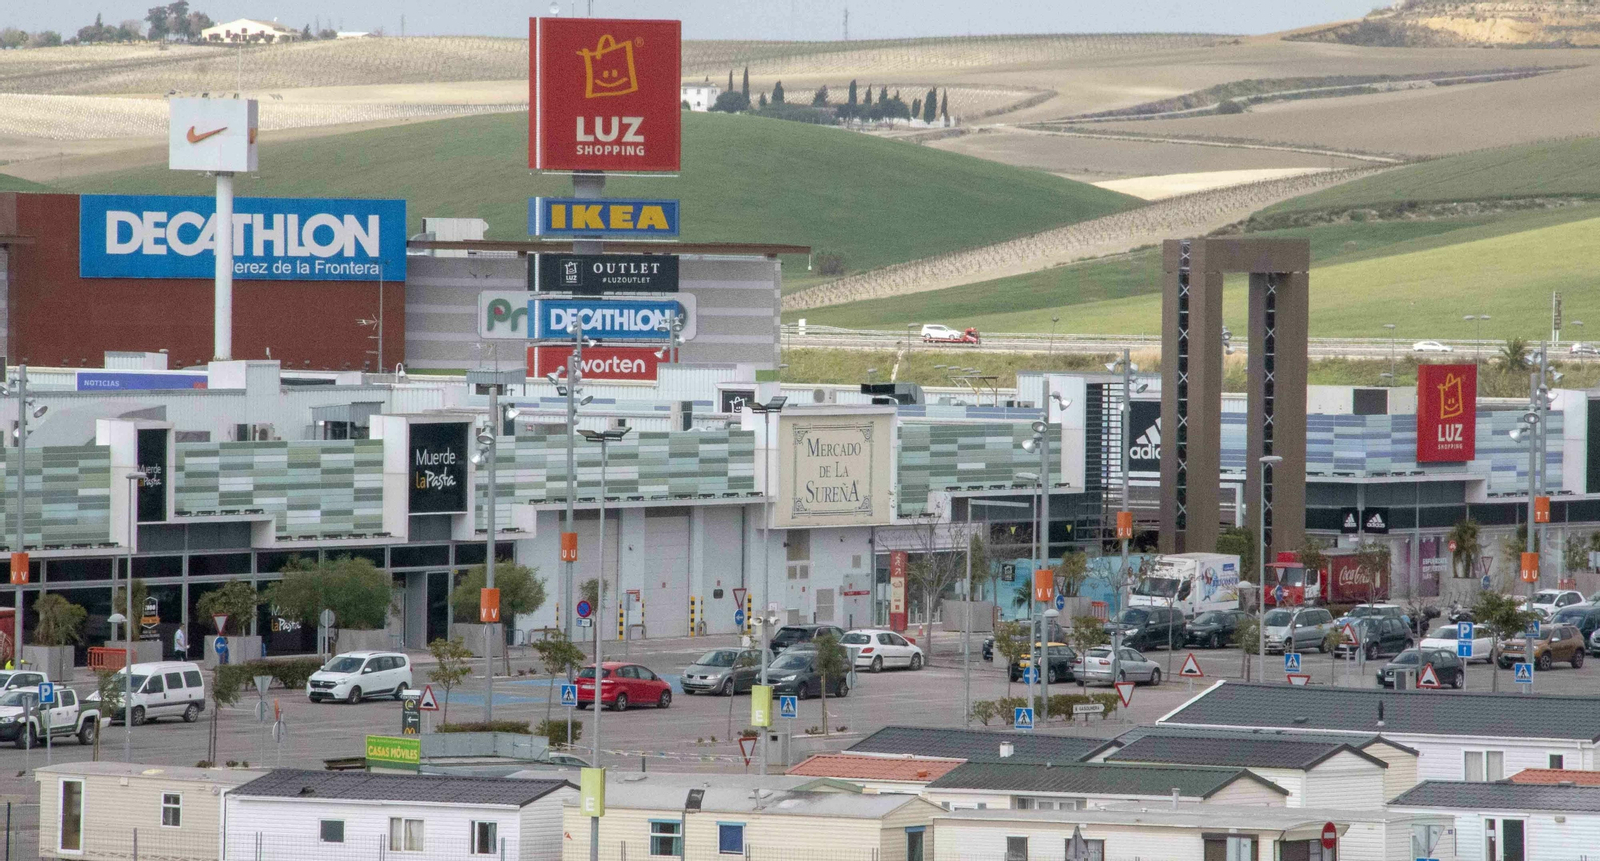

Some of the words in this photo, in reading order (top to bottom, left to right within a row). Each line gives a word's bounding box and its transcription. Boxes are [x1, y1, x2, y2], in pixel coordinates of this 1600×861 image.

[576, 116, 645, 142] LUZ
[576, 145, 645, 156] SHOPPING
[551, 204, 670, 229] IKEA
[105, 210, 380, 257] DECATHLON
[272, 260, 291, 274] de
[296, 260, 310, 274] la
[315, 260, 380, 275] Frontera
[592, 263, 660, 274] OUTLET
[550, 308, 671, 331] DECATHLON
[1438, 424, 1463, 442] LUZ
[415, 447, 456, 466] Muerde
[806, 438, 862, 457] MERCADO
[819, 466, 832, 478] DE
[835, 462, 849, 478] LA
[805, 480, 859, 504] SUREÑA
[1460, 624, 1470, 638] P
[41, 684, 51, 702] P
[755, 710, 764, 723] E
[368, 745, 390, 758] CASAS
[391, 746, 418, 761] MÓVILES
[585, 796, 595, 812] E
